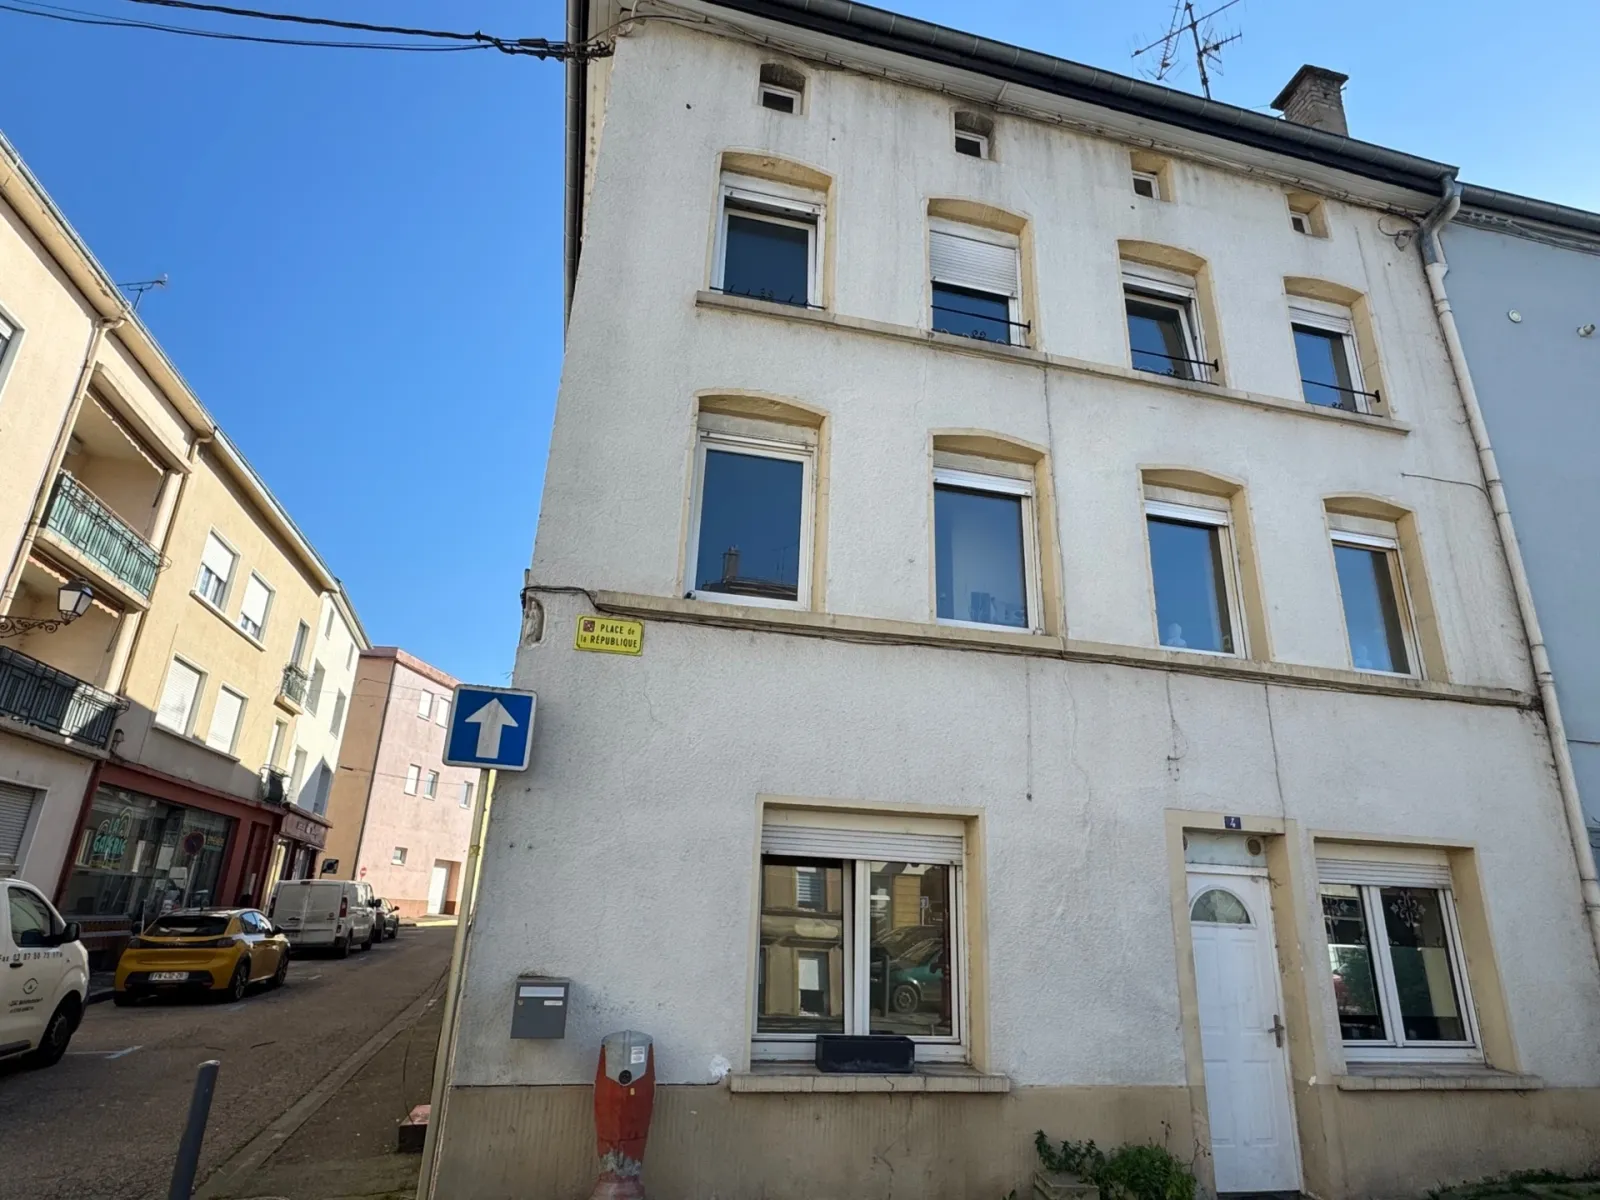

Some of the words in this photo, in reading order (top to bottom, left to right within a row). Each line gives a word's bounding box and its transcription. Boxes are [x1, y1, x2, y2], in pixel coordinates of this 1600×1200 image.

[600, 624, 624, 634] PLACE
[627, 627, 635, 635] de
[580, 634, 587, 643] la
[590, 634, 638, 648] RÉPUBLIQUE
